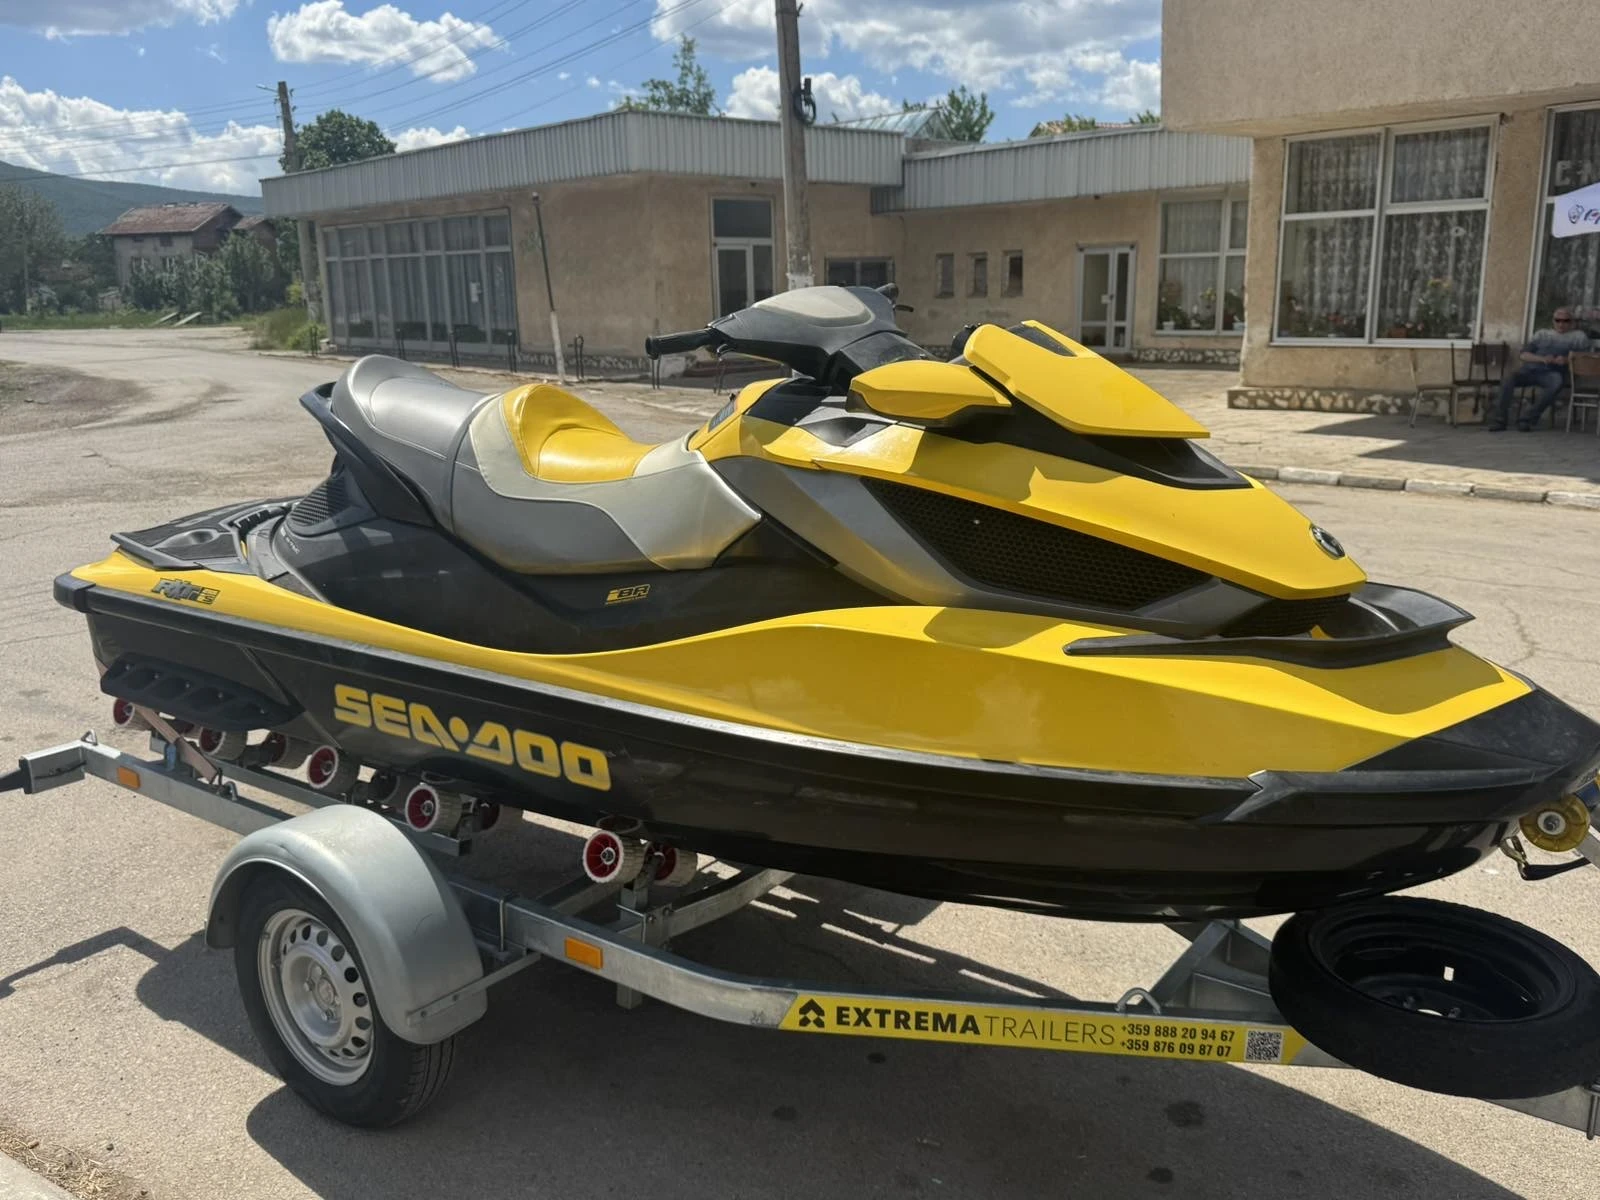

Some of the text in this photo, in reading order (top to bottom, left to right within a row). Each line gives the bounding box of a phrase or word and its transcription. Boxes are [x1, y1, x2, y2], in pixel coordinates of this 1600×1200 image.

[836, 1006, 1115, 1045] EXTREMA TRAILERS
[1122, 1023, 1235, 1043] +359 888 20 94 67
[1121, 1038, 1232, 1058] +359 876 09 87 07
